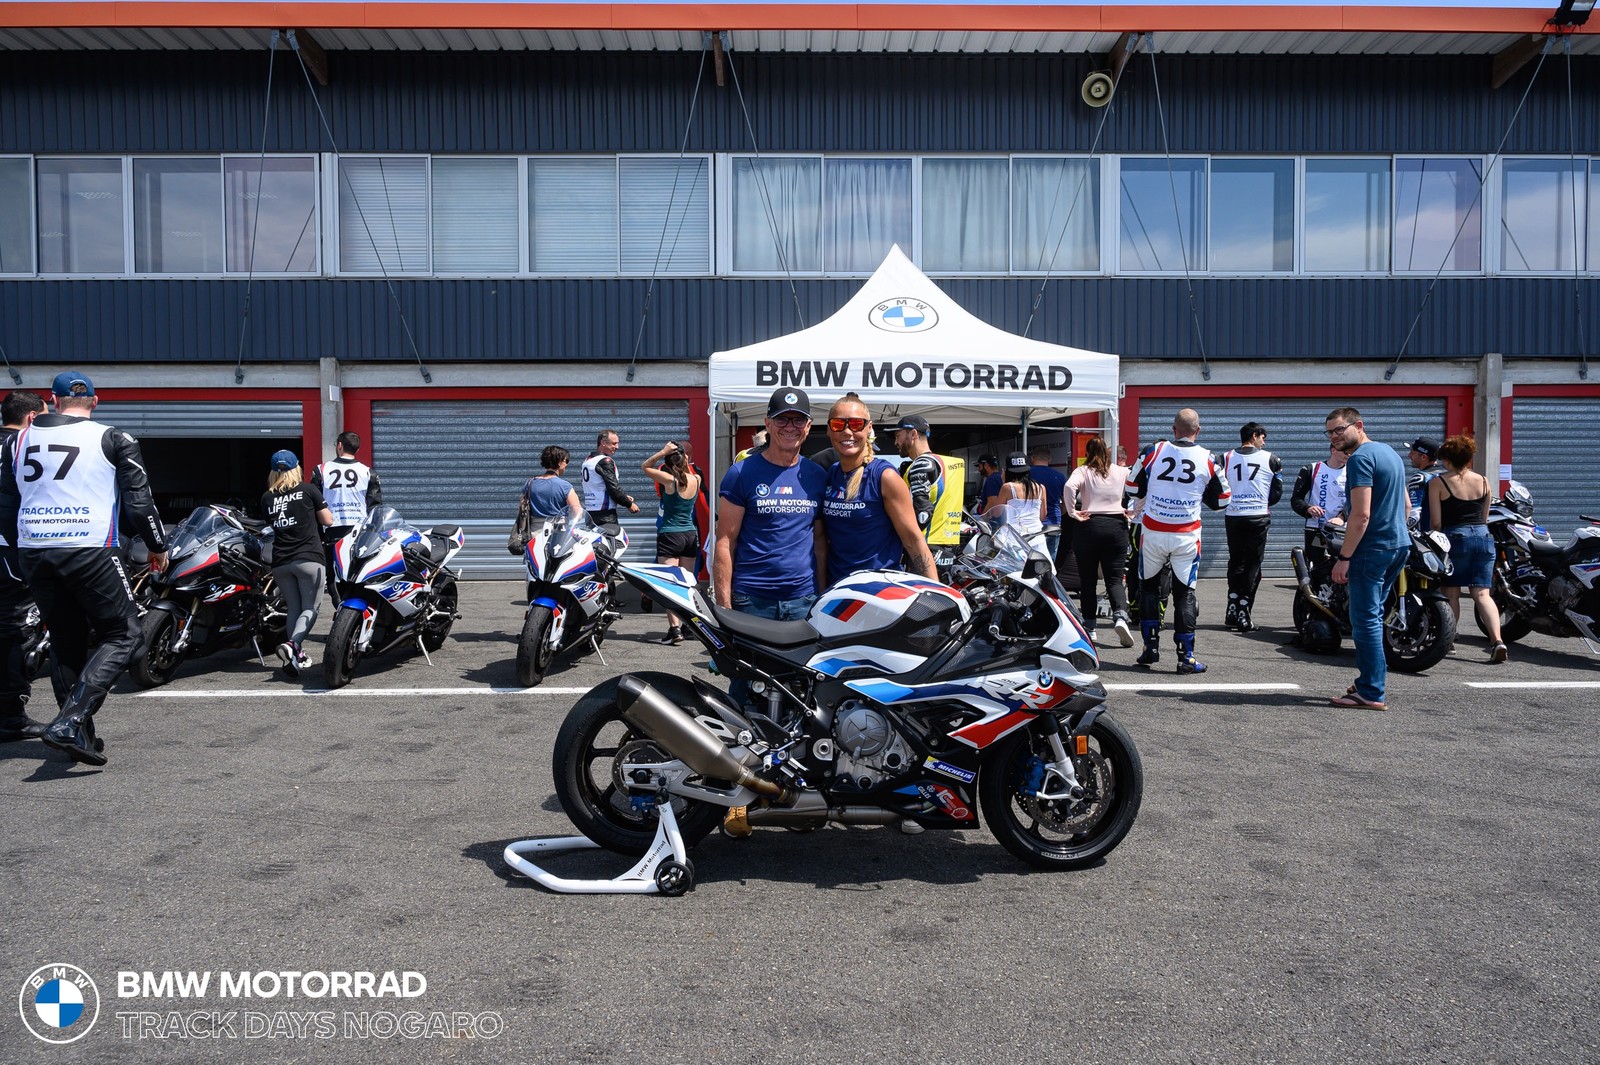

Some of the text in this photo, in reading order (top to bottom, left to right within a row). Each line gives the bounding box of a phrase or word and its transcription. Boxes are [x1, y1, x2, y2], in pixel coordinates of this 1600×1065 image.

[877, 299, 927, 312] BMW
[756, 360, 1073, 391] BMW MOTORRAD
[23, 444, 80, 483] 57
[1156, 456, 1196, 484] 23
[328, 468, 359, 490] 29
[1233, 463, 1260, 482] 17
[273, 491, 303, 506] MAKE
[756, 499, 778, 507] BMW
[779, 499, 818, 508] MOTORRAD
[1151, 494, 1197, 507] TRACKDAYS
[1317, 473, 1329, 523] TCKDAYS
[21, 506, 91, 516] TRACKDAYS
[268, 502, 288, 515] LIFE
[757, 506, 811, 514] MOTORSPORT
[830, 501, 866, 510] MOTORRAD
[278, 511, 286, 520] A
[31, 531, 90, 539] MICHELIN
[938, 764, 973, 780] MICHELIN
